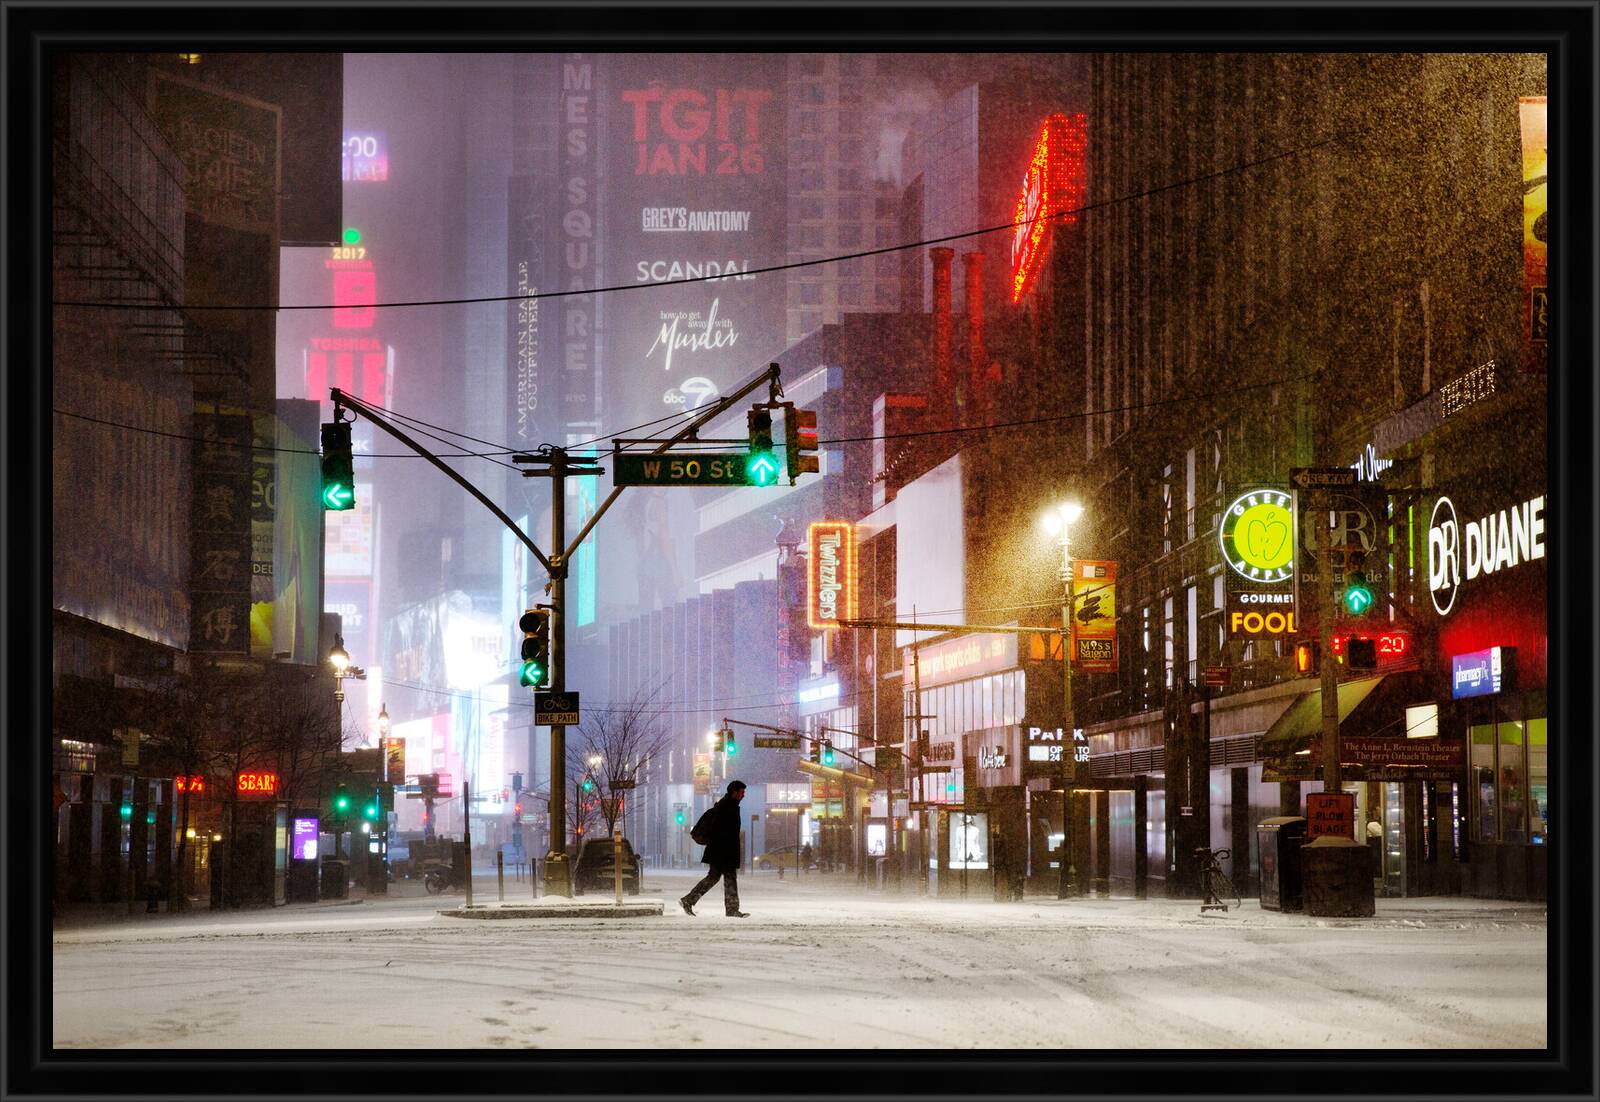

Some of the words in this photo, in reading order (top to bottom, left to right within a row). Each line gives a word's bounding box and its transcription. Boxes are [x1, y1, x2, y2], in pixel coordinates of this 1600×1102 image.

[563, 53, 592, 157] MES
[622, 88, 771, 142] TGIT
[635, 143, 707, 176] JAN
[715, 143, 765, 175] 26
[642, 207, 687, 231] GREY'S
[688, 211, 751, 231] ANATOMY
[562, 177, 593, 372] SQUARE
[637, 260, 756, 282] SCANDAL
[517, 331, 528, 438] AMERICAN
[643, 461, 661, 479] W
[671, 461, 701, 479] 50
[710, 461, 734, 478] St
[1233, 492, 1293, 517] GREE
[1465, 495, 1545, 580] DUANE
[819, 530, 842, 620] Twizzlers
[537, 713, 555, 722] BIKE
[559, 713, 577, 721] PATH
[1344, 742, 1360, 751] The
[1431, 742, 1461, 752] Theater
[1355, 752, 1371, 760] The
[1420, 752, 1450, 761] Theater
[779, 790, 808, 801] FOSS
[1319, 800, 1339, 809] LIFT
[1316, 812, 1345, 821] PLOW
[1313, 824, 1346, 833] BLADE
